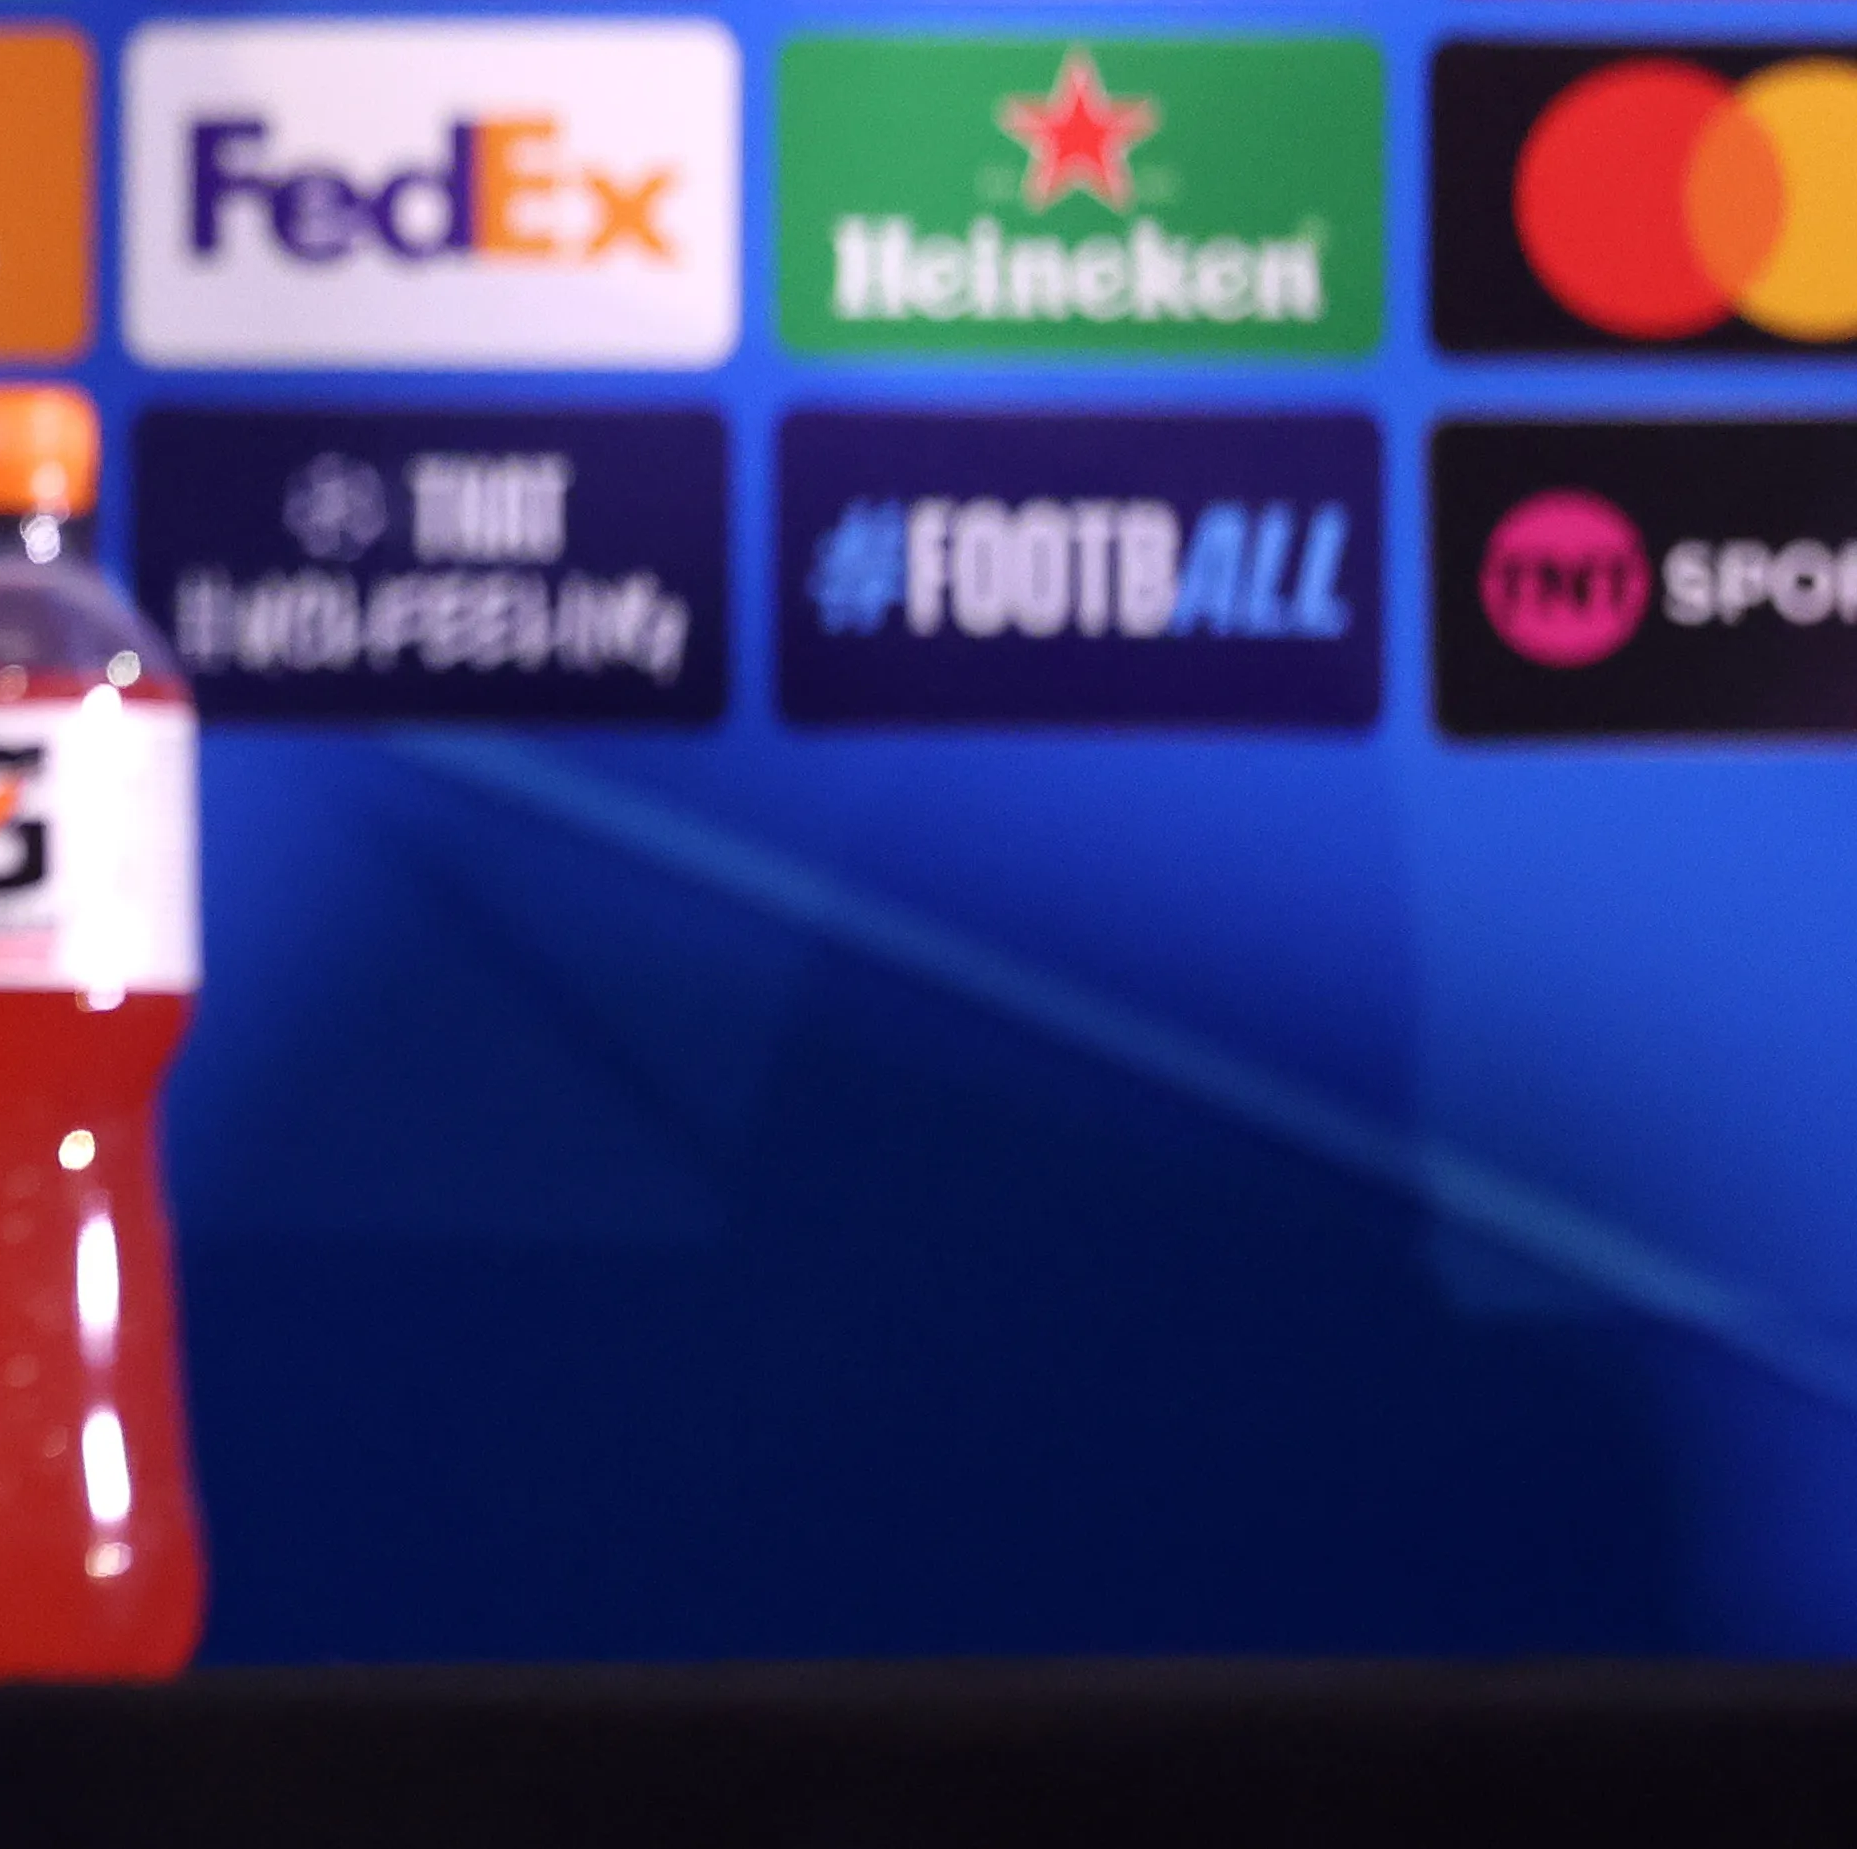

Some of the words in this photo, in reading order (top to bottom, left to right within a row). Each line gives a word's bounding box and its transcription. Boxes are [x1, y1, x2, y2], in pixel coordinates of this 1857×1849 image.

[185, 109, 678, 267] FedEx
[833, 211, 1321, 322] Heineken
[808, 499, 1352, 640] #FOOTBALL
[1662, 538, 1857, 627] SPO
